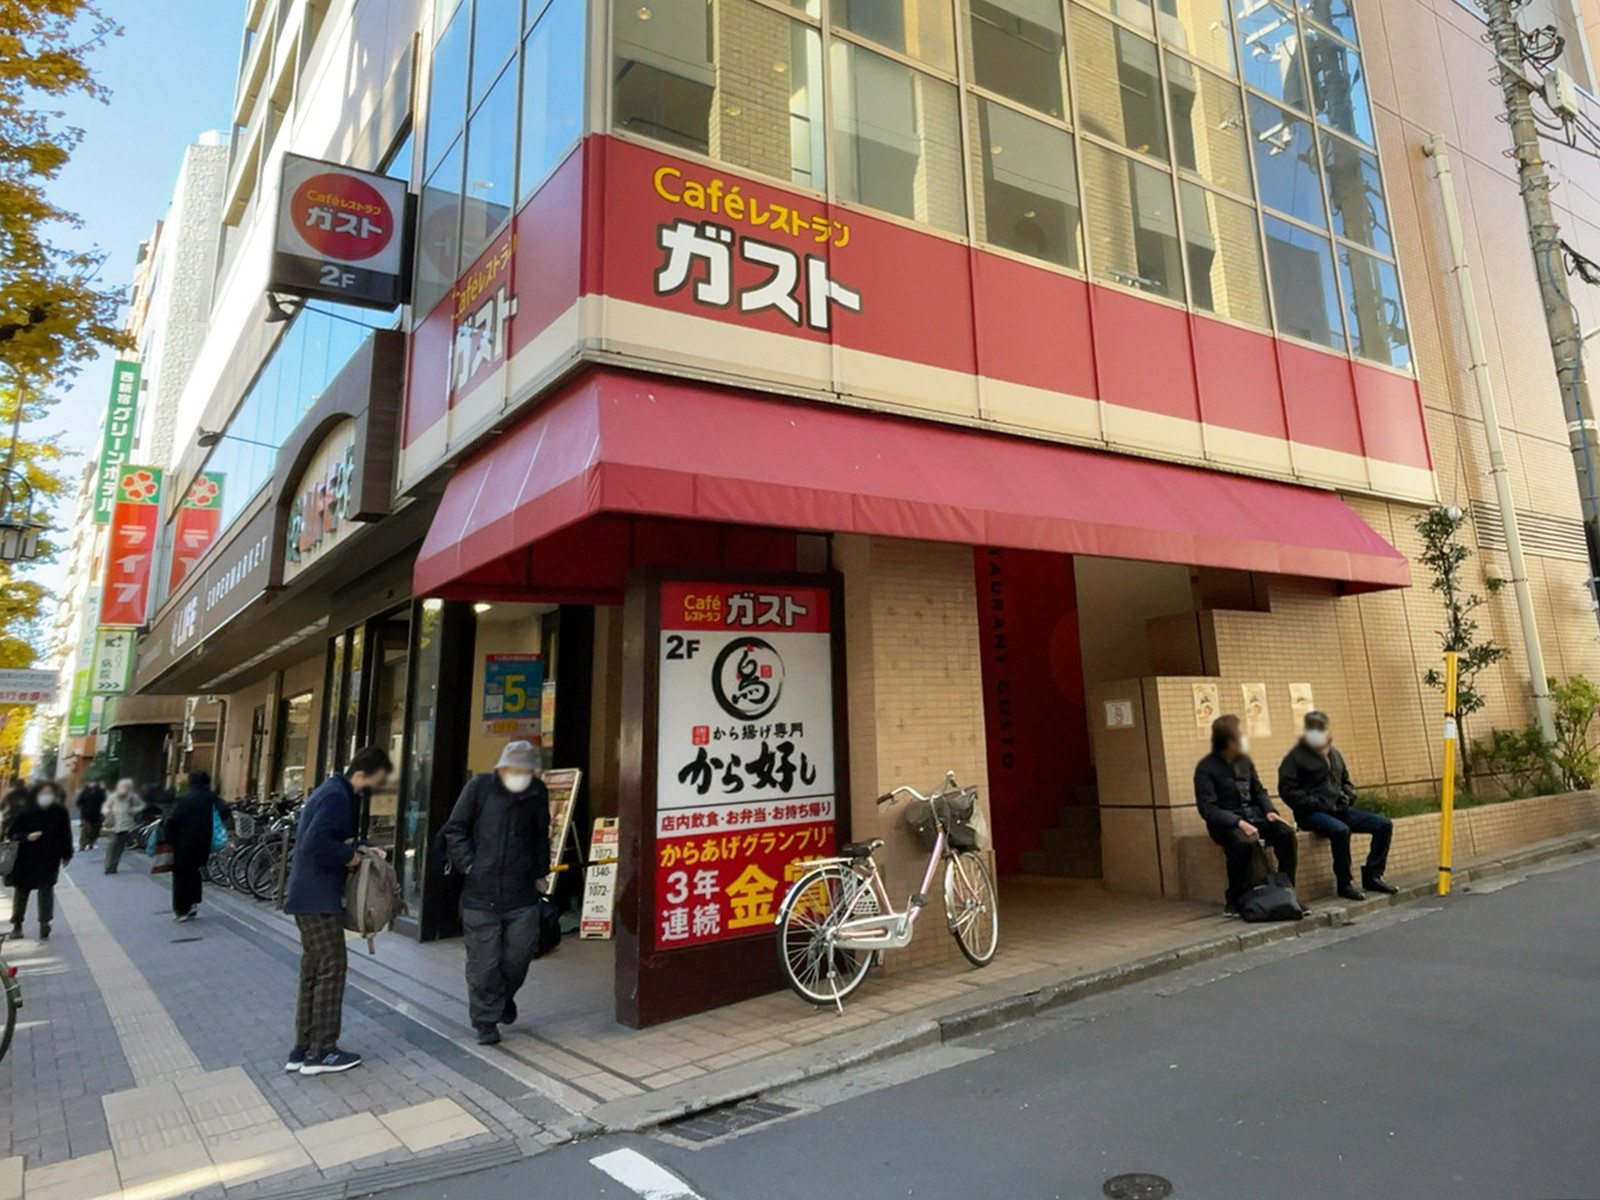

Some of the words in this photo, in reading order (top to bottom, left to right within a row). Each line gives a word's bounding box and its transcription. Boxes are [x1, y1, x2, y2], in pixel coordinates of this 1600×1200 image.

[305, 207, 383, 239] ガスト
[653, 166, 851, 248] Caféレストラン
[319, 265, 356, 289] 2F
[655, 219, 863, 330] ガスト
[112, 525, 148, 603] ライフ
[206, 535, 268, 612] SUPERMARKET
[684, 594, 721, 611] Café
[726, 592, 807, 626] ガスト
[665, 635, 700, 660] 2F
[504, 674, 526, 713] 5
[713, 722, 804, 741] から揚げ専門
[678, 741, 817, 795] から好し
[666, 869, 720, 904] 3年
[661, 904, 721, 942] 連続
